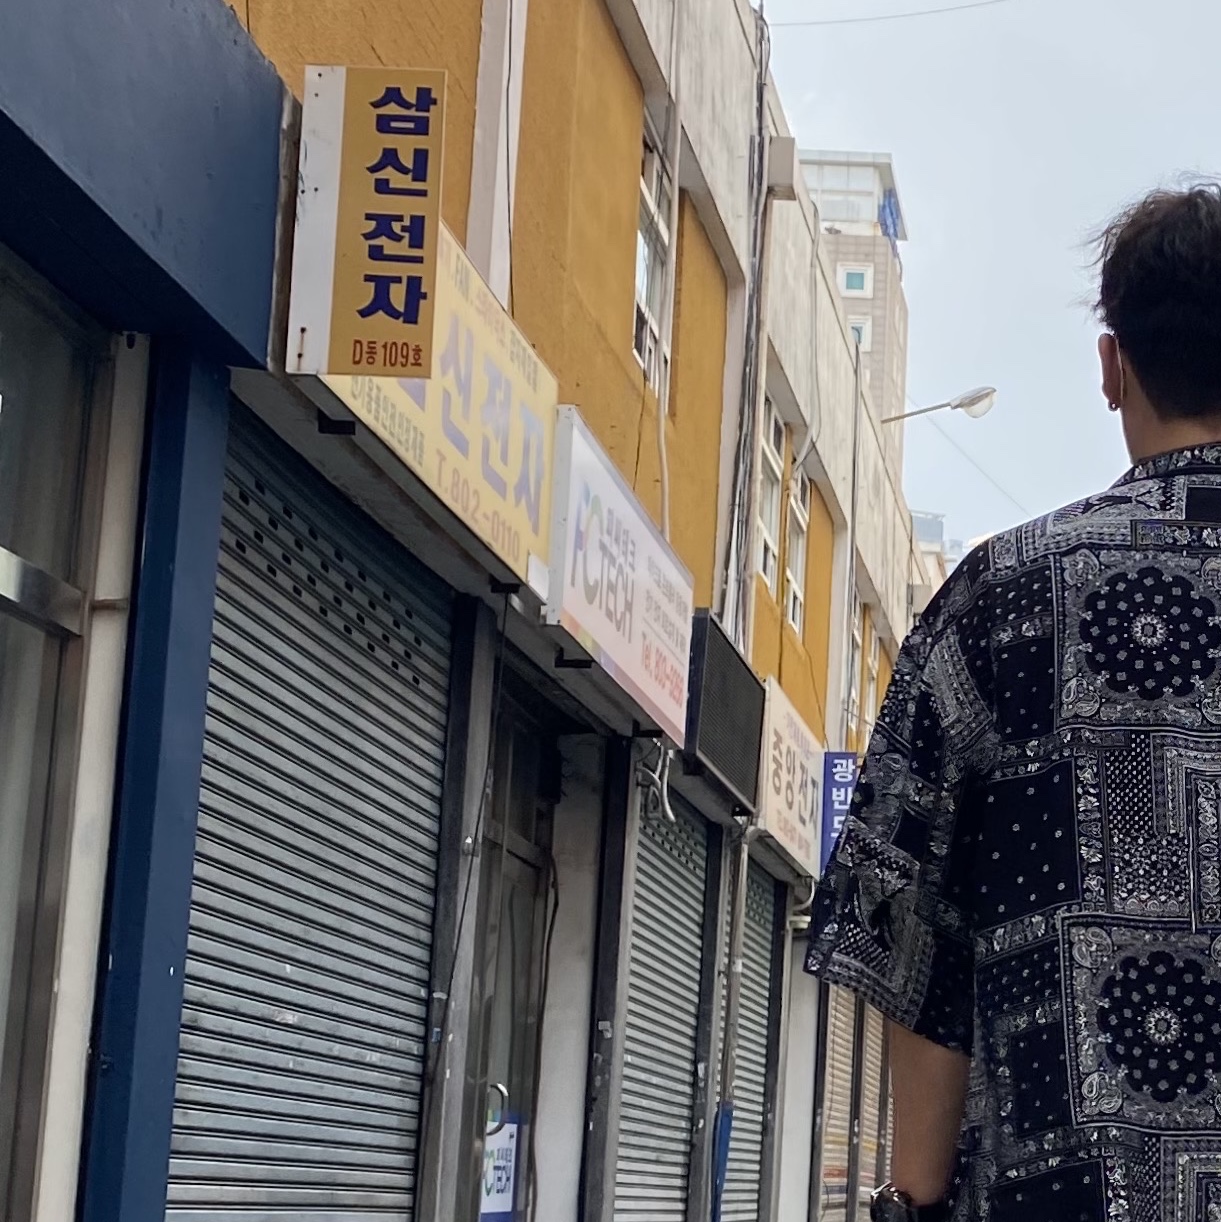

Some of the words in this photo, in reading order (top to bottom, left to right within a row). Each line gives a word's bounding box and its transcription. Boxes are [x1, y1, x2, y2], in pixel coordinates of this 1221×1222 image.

[356, 86, 438, 325] 삼신전자
[397, 312, 545, 538] 신전자
[772, 728, 819, 841] 중앙전자
